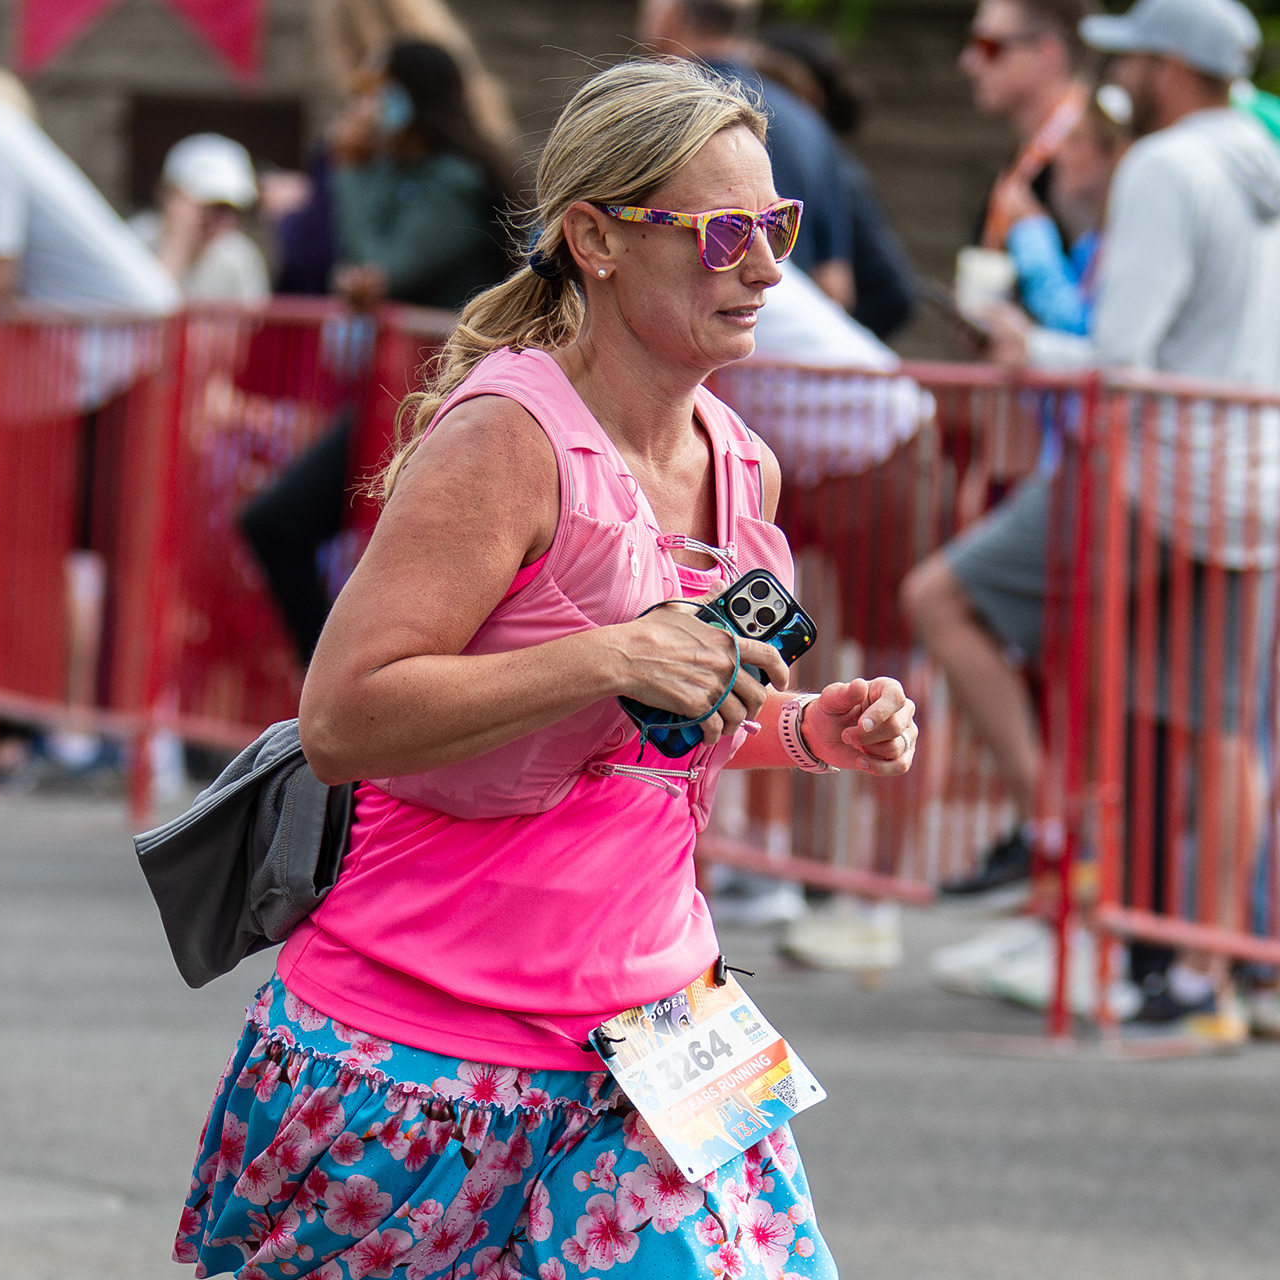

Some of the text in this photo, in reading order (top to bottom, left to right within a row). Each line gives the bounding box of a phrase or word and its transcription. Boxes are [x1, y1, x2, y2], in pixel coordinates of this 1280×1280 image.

[649, 995, 688, 1022] OGDEN
[748, 1029, 767, 1042] GOAL
[657, 1030, 733, 1090] 3264
[682, 1086, 720, 1113] YEARS
[719, 1053, 772, 1093] RUNNING
[731, 1115, 763, 1140] 13.1
